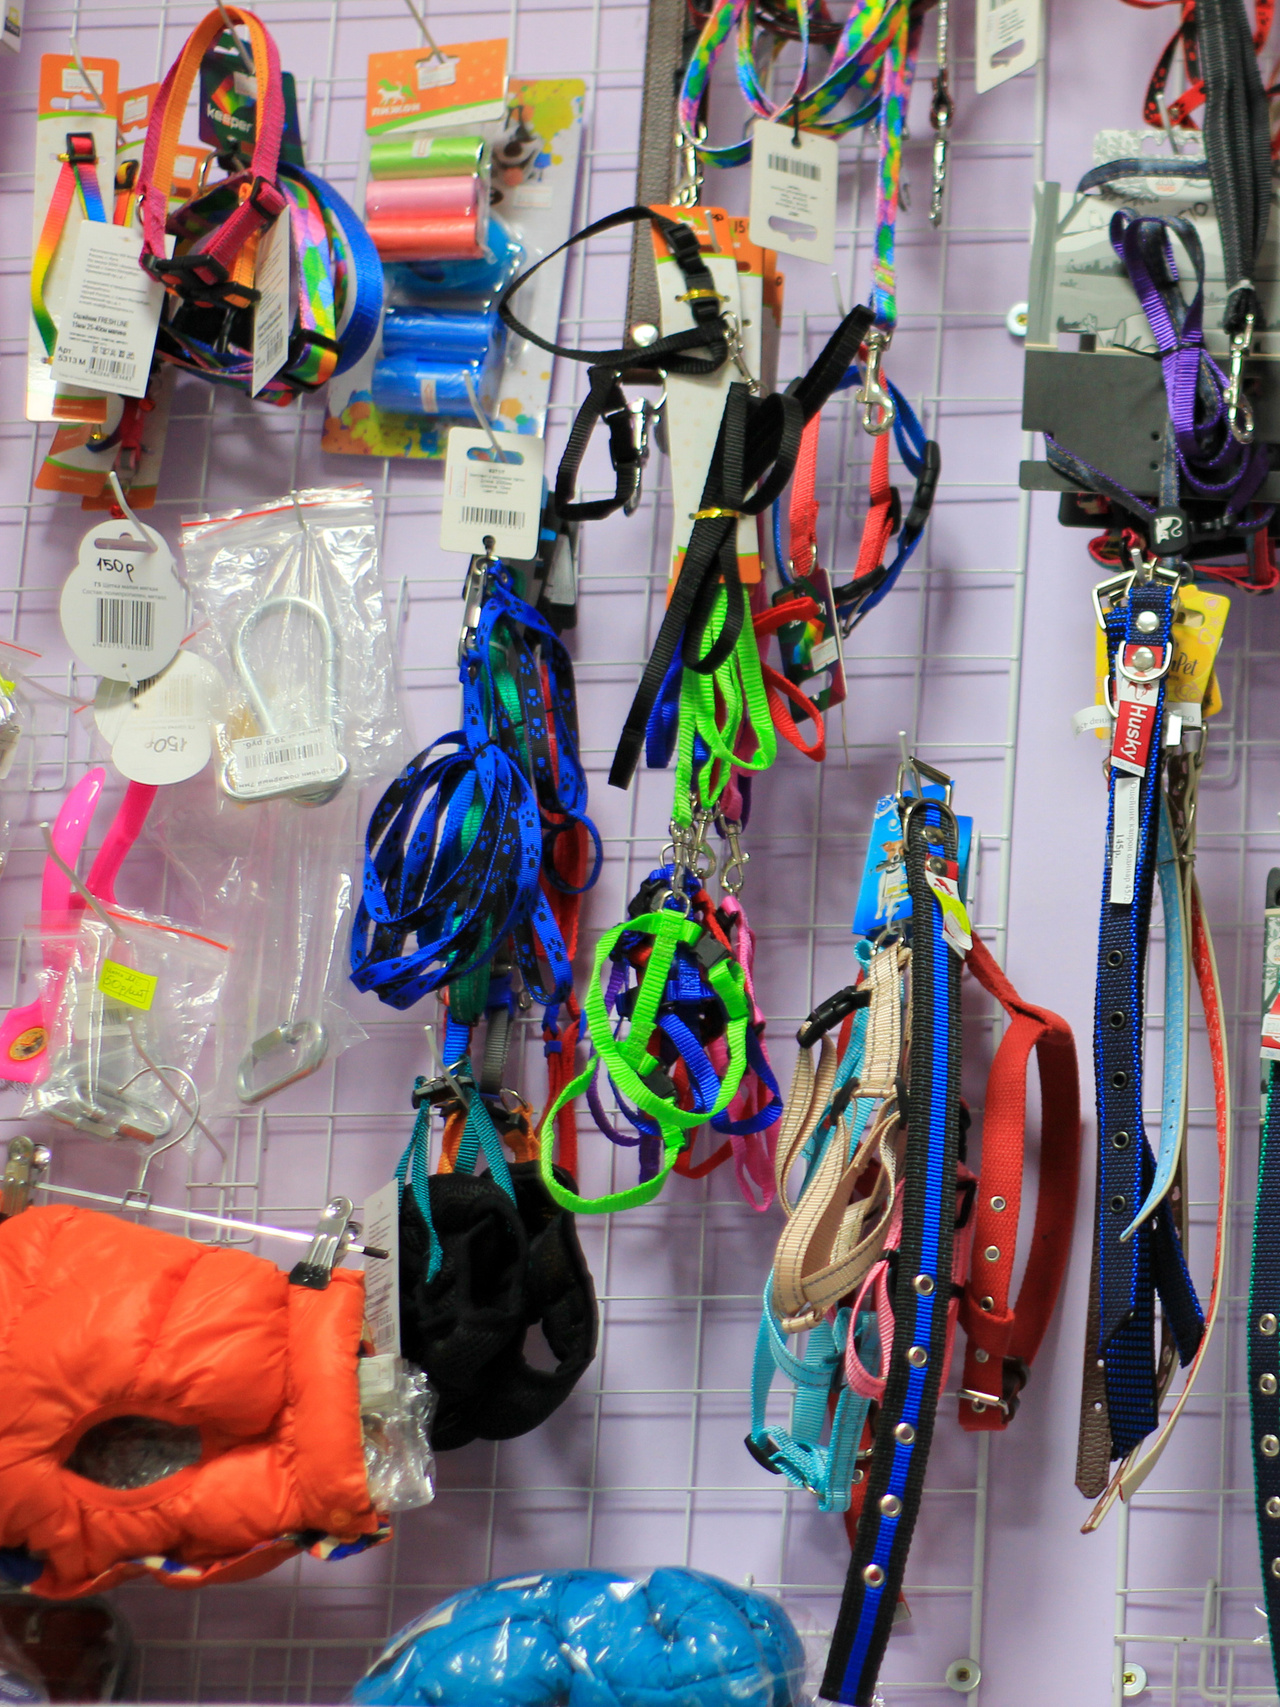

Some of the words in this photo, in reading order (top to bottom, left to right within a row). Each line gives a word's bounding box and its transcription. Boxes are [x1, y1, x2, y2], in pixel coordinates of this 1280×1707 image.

[207, 103, 254, 132] keeper
[58, 354, 77, 364] 5313
[1125, 705, 1148, 760] Husky
[1129, 783, 1138, 821] Ошейник
